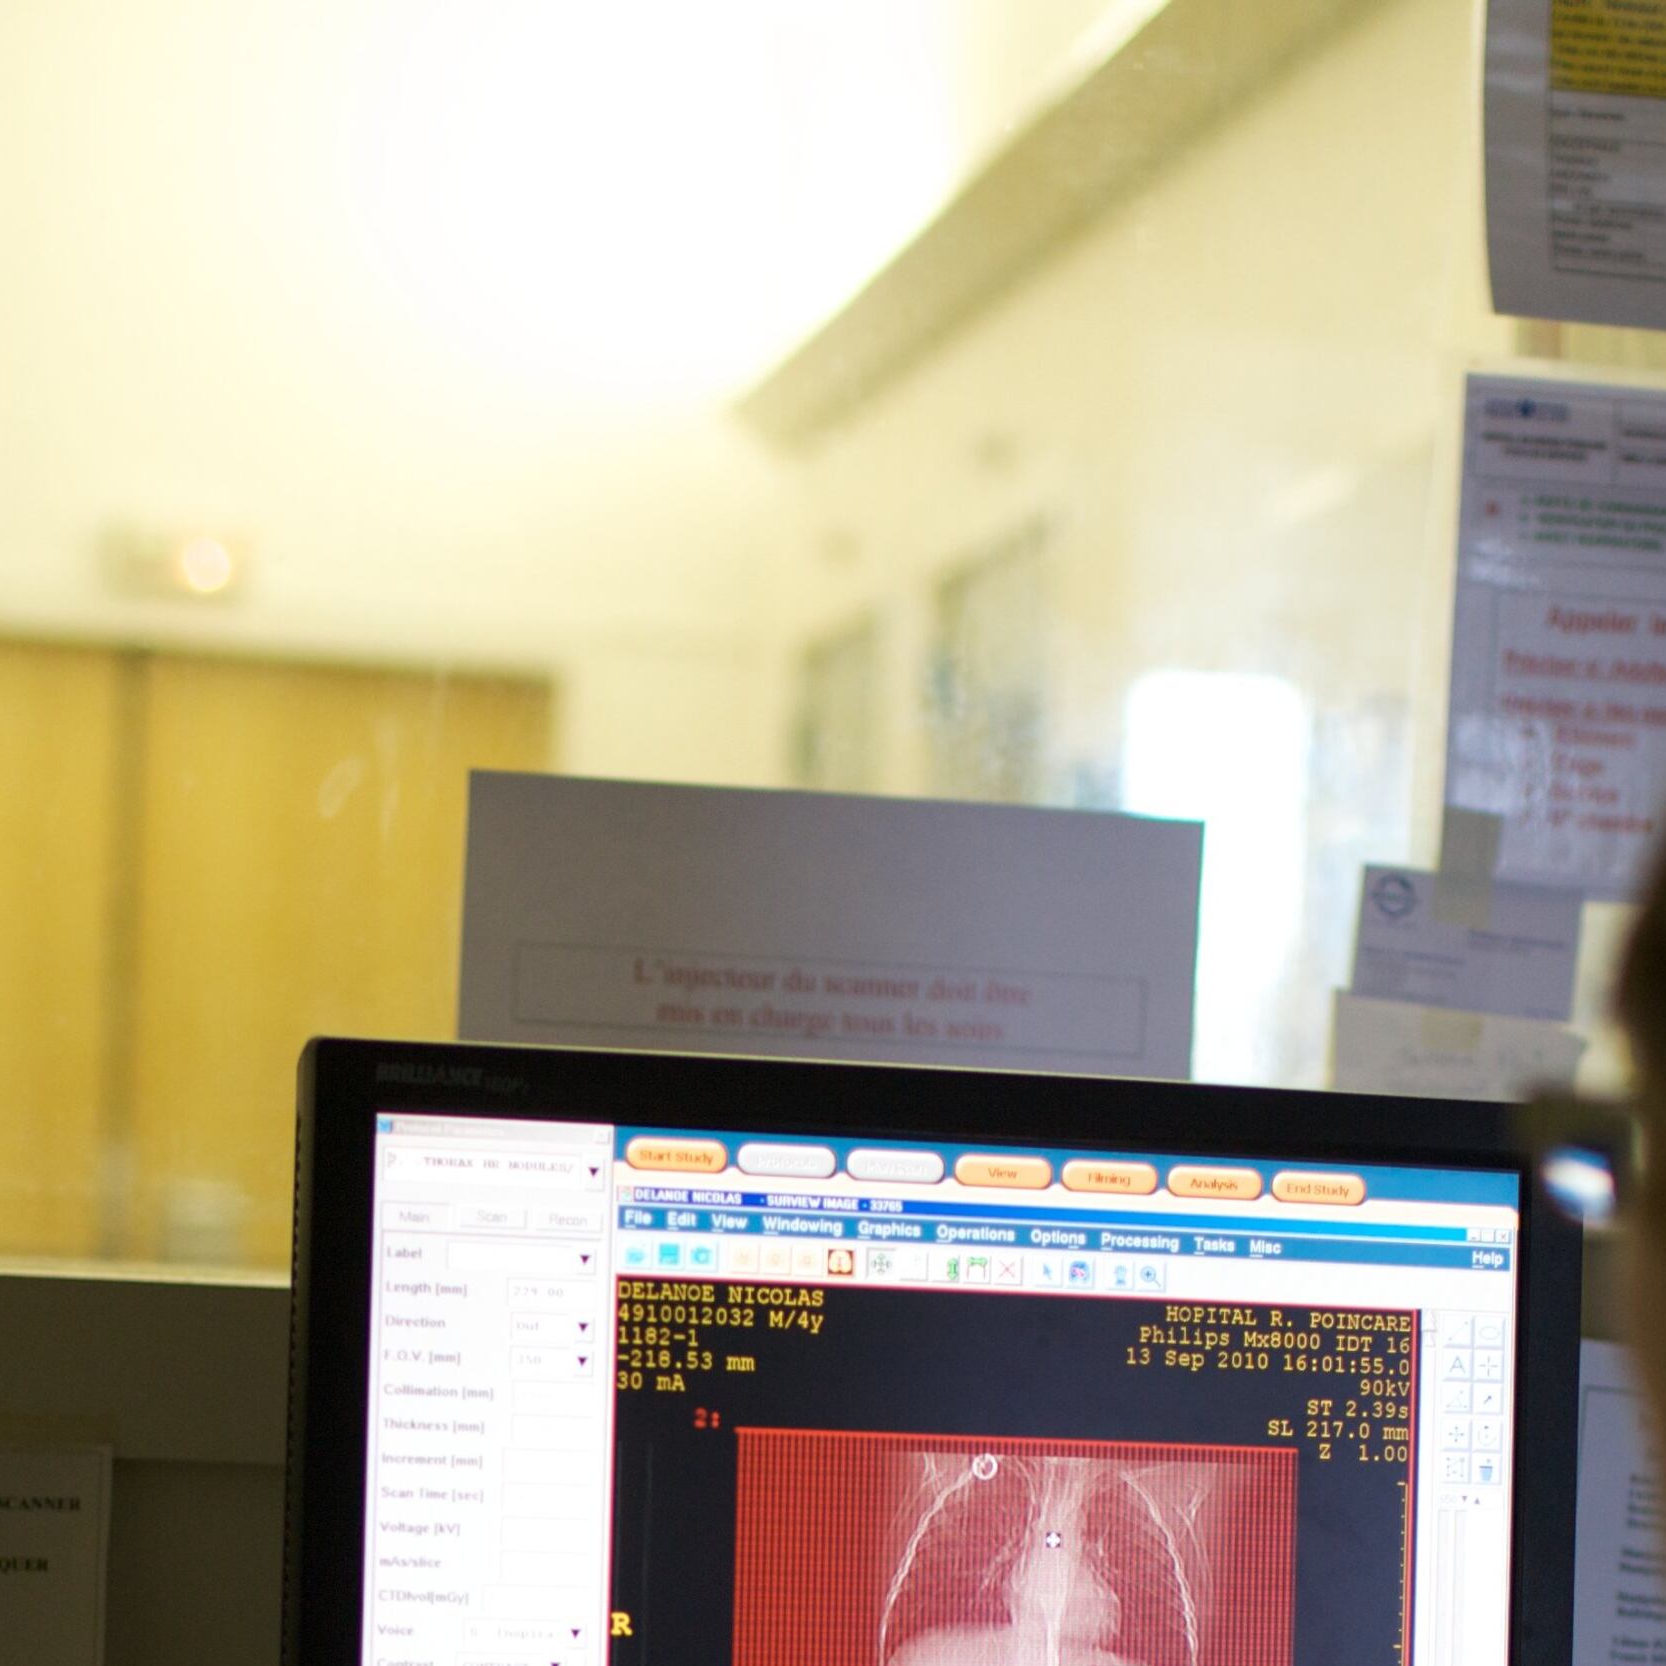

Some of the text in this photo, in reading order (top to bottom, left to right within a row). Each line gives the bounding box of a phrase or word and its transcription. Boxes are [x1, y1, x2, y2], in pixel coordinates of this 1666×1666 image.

[640, 1150, 715, 1167] Start Study
[989, 1168, 1019, 1180] View
[1088, 1171, 1131, 1187] Filming
[1190, 1177, 1239, 1193] Analysis
[1286, 1182, 1350, 1199] End Study
[692, 1189, 742, 1204] NICOLAS
[767, 1193, 820, 1209] SURVIEW
[822, 1196, 859, 1210] IMAGE
[624, 1210, 1282, 1255] File Edit View Windowing Graphics Operations Options Processing Tasks Misc
[386, 1246, 423, 1258] Label
[1472, 1250, 1504, 1268] Help
[385, 1282, 432, 1296] Length
[617, 1281, 824, 1306] DELANOE NICOLAS
[384, 1314, 447, 1328] Direction
[617, 1304, 824, 1333] 4910012032 M/4y
[1166, 1306, 1411, 1333] HOPITAL R. POINCARE
[618, 1326, 699, 1347] 1182-1
[1140, 1326, 1410, 1354] Philips Mx8000 IDT 16
[617, 1348, 755, 1371] -218.53 mm
[1126, 1347, 1410, 1376] 13 Sep 2010 16:01:55.0
[384, 1383, 458, 1397] Collimation
[617, 1372, 686, 1391] 30 mA
[1360, 1379, 1411, 1398] 90kV
[1308, 1400, 1410, 1419] ST 2.39s
[383, 1418, 449, 1432] Thickness
[1268, 1420, 1410, 1440] SL 217.0 mm
[382, 1453, 447, 1467] Increment
[1319, 1444, 1409, 1462] Z 1.00
[381, 1486, 448, 1500] Scan Time
[380, 1521, 429, 1536] Voltage
[611, 1611, 633, 1637] R
